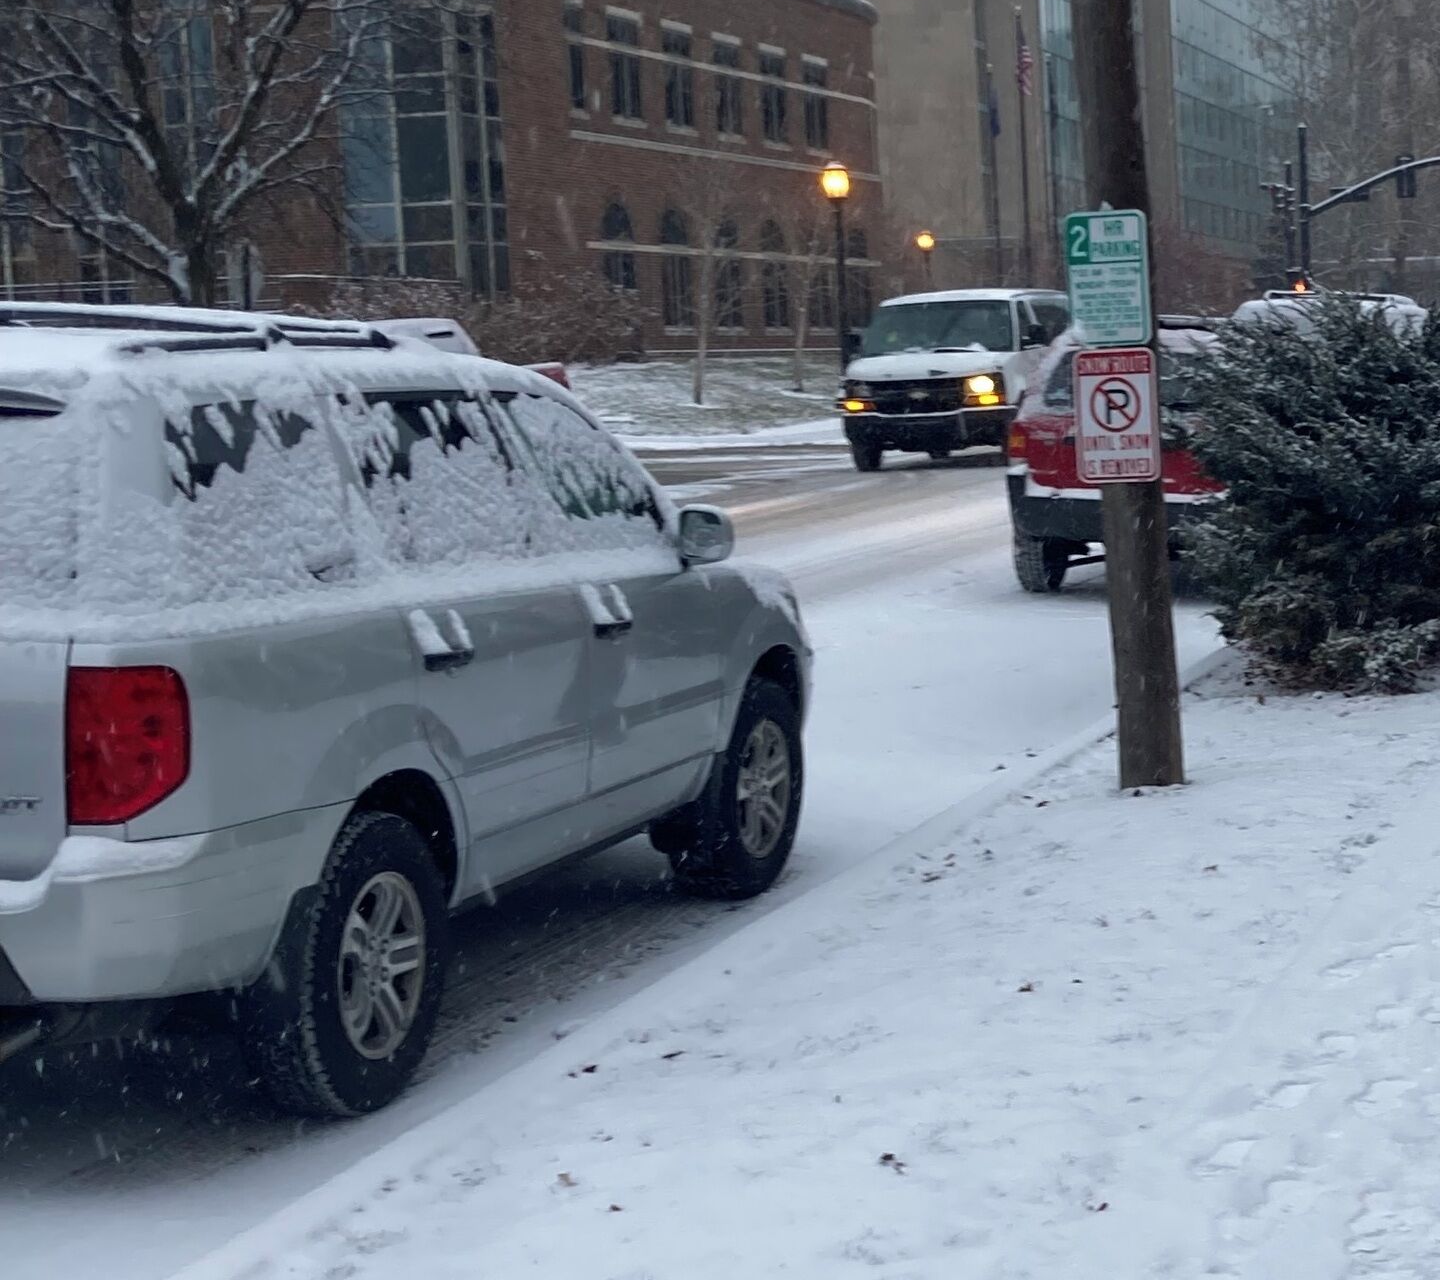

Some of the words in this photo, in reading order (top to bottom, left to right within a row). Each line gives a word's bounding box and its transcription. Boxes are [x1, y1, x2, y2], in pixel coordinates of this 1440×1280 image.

[1103, 220, 1125, 236] HR
[1070, 225, 1088, 257] 2
[1091, 240, 1140, 257] PARKING
[1079, 357, 1110, 374] SNOW
[1111, 355, 1149, 373] ROUTE
[1083, 436, 1115, 451] UNTIL
[1119, 434, 1149, 450] SNOW
[1084, 460, 1096, 475] IS
[1100, 458, 1150, 474] REMOVED
